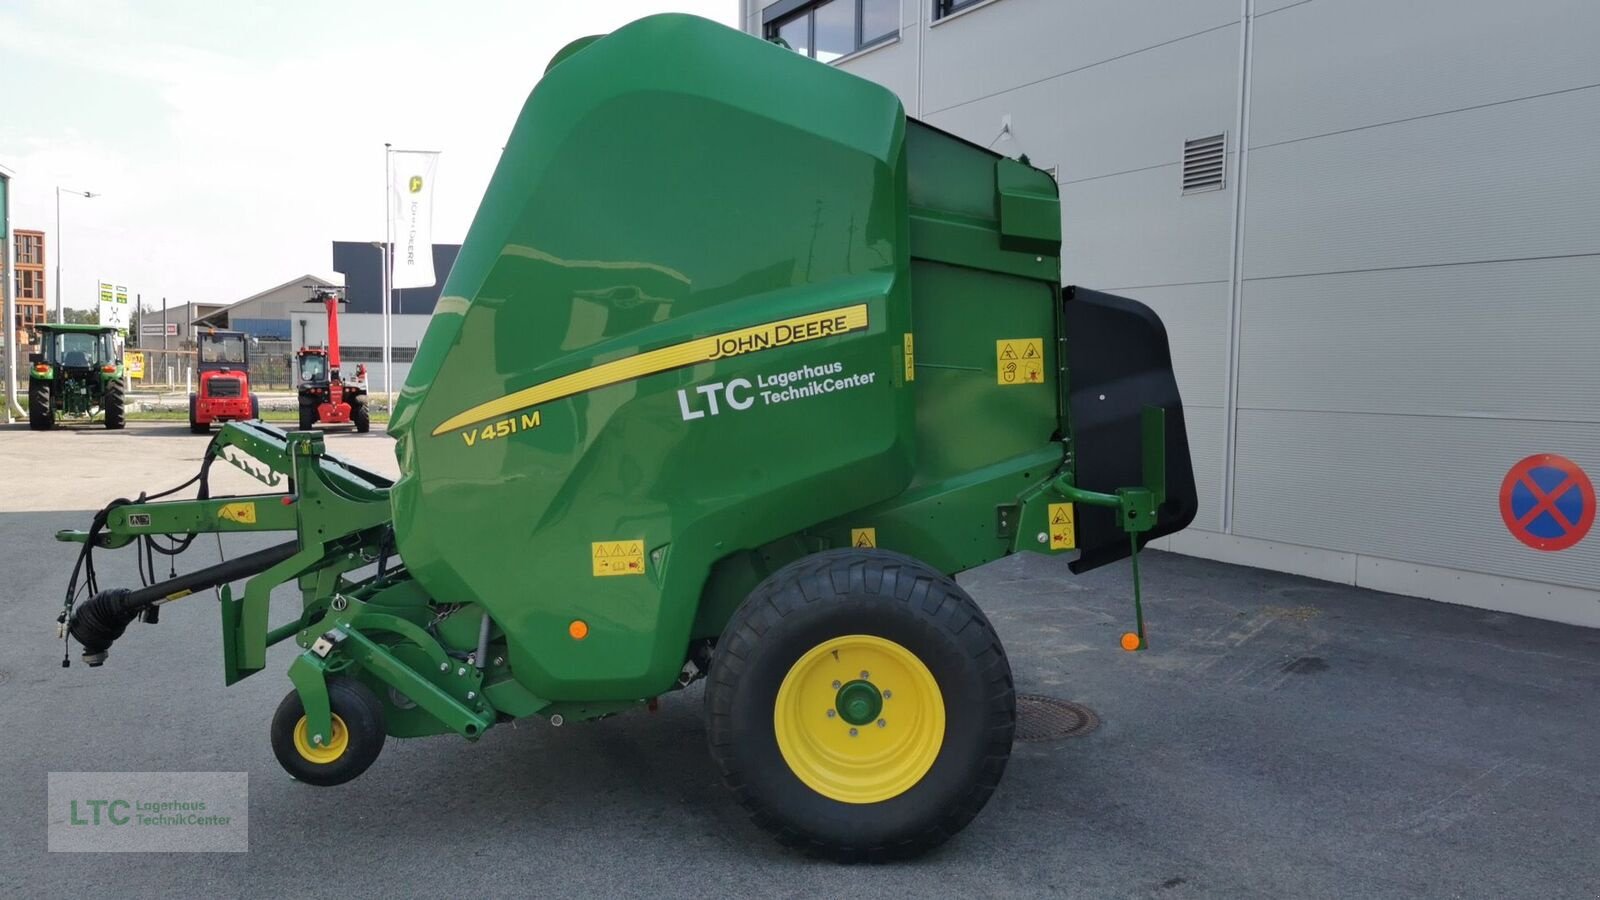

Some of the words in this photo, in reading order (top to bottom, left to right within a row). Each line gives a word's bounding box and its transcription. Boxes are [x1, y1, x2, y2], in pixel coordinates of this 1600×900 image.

[709, 331, 769, 358] JOHN
[775, 315, 848, 344] DEERE
[757, 361, 843, 388] Lagerhaus
[760, 371, 876, 405] TechnikCenter
[677, 378, 755, 421] LTC
[462, 428, 478, 447] V
[481, 417, 517, 440] 451
[521, 410, 540, 430] M
